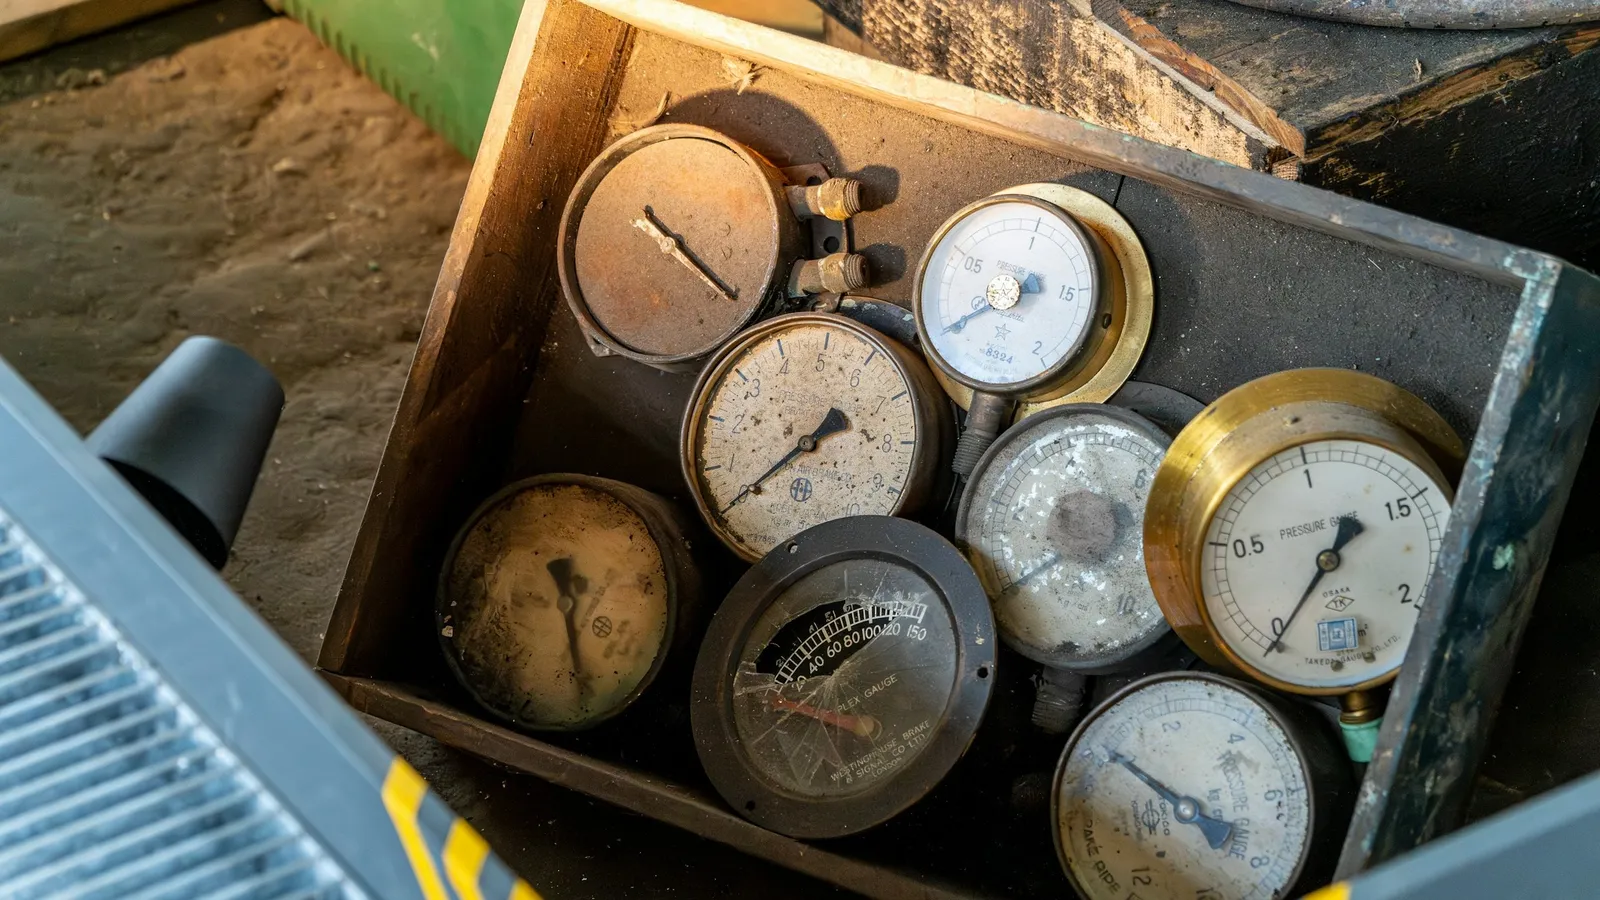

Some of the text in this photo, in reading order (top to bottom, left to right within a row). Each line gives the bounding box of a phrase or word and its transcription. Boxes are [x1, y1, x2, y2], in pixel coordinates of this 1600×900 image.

[1028, 236, 1035, 251] 1
[963, 255, 984, 274] 0.5
[996, 259, 1026, 277] PRESSURE
[1058, 284, 1076, 302] 1.5
[985, 347, 1014, 364] 8324
[1031, 340, 1043, 356] 2
[779, 358, 790, 374] 4
[815, 353, 827, 373] 5
[748, 378, 760, 398] 3
[849, 368, 862, 388] 6
[876, 394, 888, 415] 7
[731, 413, 745, 435] 2
[881, 433, 893, 454] 8
[1134, 468, 1147, 489] 6
[1303, 468, 1313, 489] 1
[1384, 497, 1412, 521] 1.5
[1279, 518, 1327, 540] PRESSURE
[1232, 534, 1265, 558] 0.5
[1398, 583, 1413, 604] 2
[1116, 592, 1136, 616] 10
[1271, 617, 1285, 637] 0
[809, 655, 825, 674] 40
[826, 641, 842, 658] 60
[843, 631, 860, 648] 80
[862, 624, 881, 641] 100
[882, 622, 901, 636] 120
[907, 624, 927, 641] 150
[864, 673, 898, 698] GAUGE
[902, 719, 930, 741] BRAKE
[1161, 720, 1182, 734] 2
[1227, 733, 1246, 745] 4
[1264, 788, 1284, 801] 6
[1228, 816, 1250, 861] GAUGE
[1250, 855, 1271, 869] 8
[1131, 866, 1152, 887] 12
